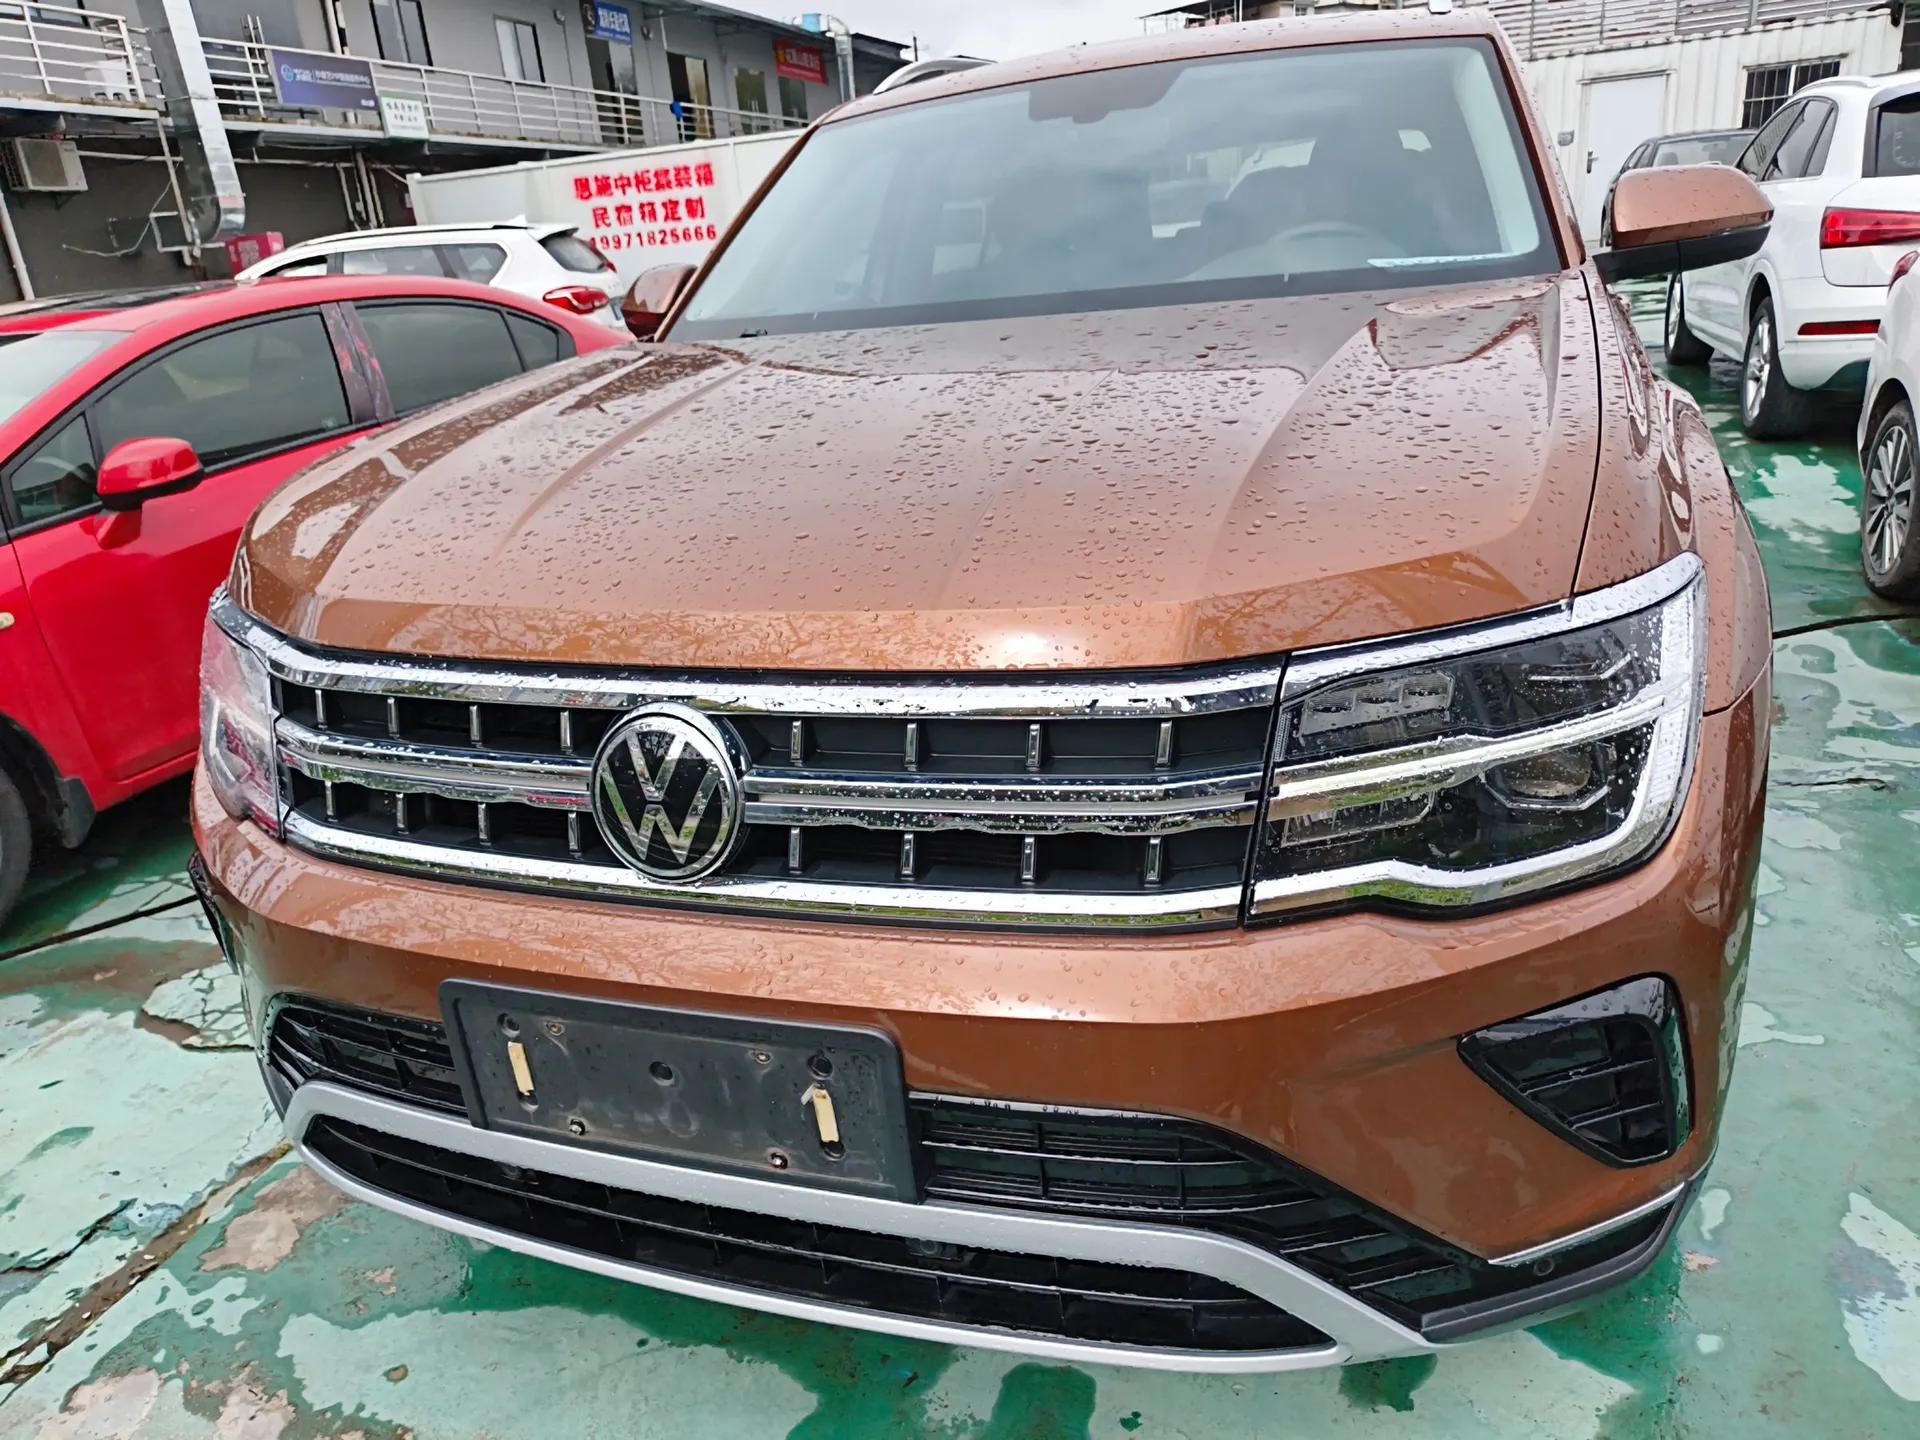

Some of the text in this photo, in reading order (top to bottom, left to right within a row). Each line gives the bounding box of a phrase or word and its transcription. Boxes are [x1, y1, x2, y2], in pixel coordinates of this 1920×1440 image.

[592, 196, 705, 228] 民宿箱定制
[590, 224, 717, 250] 19971825666
